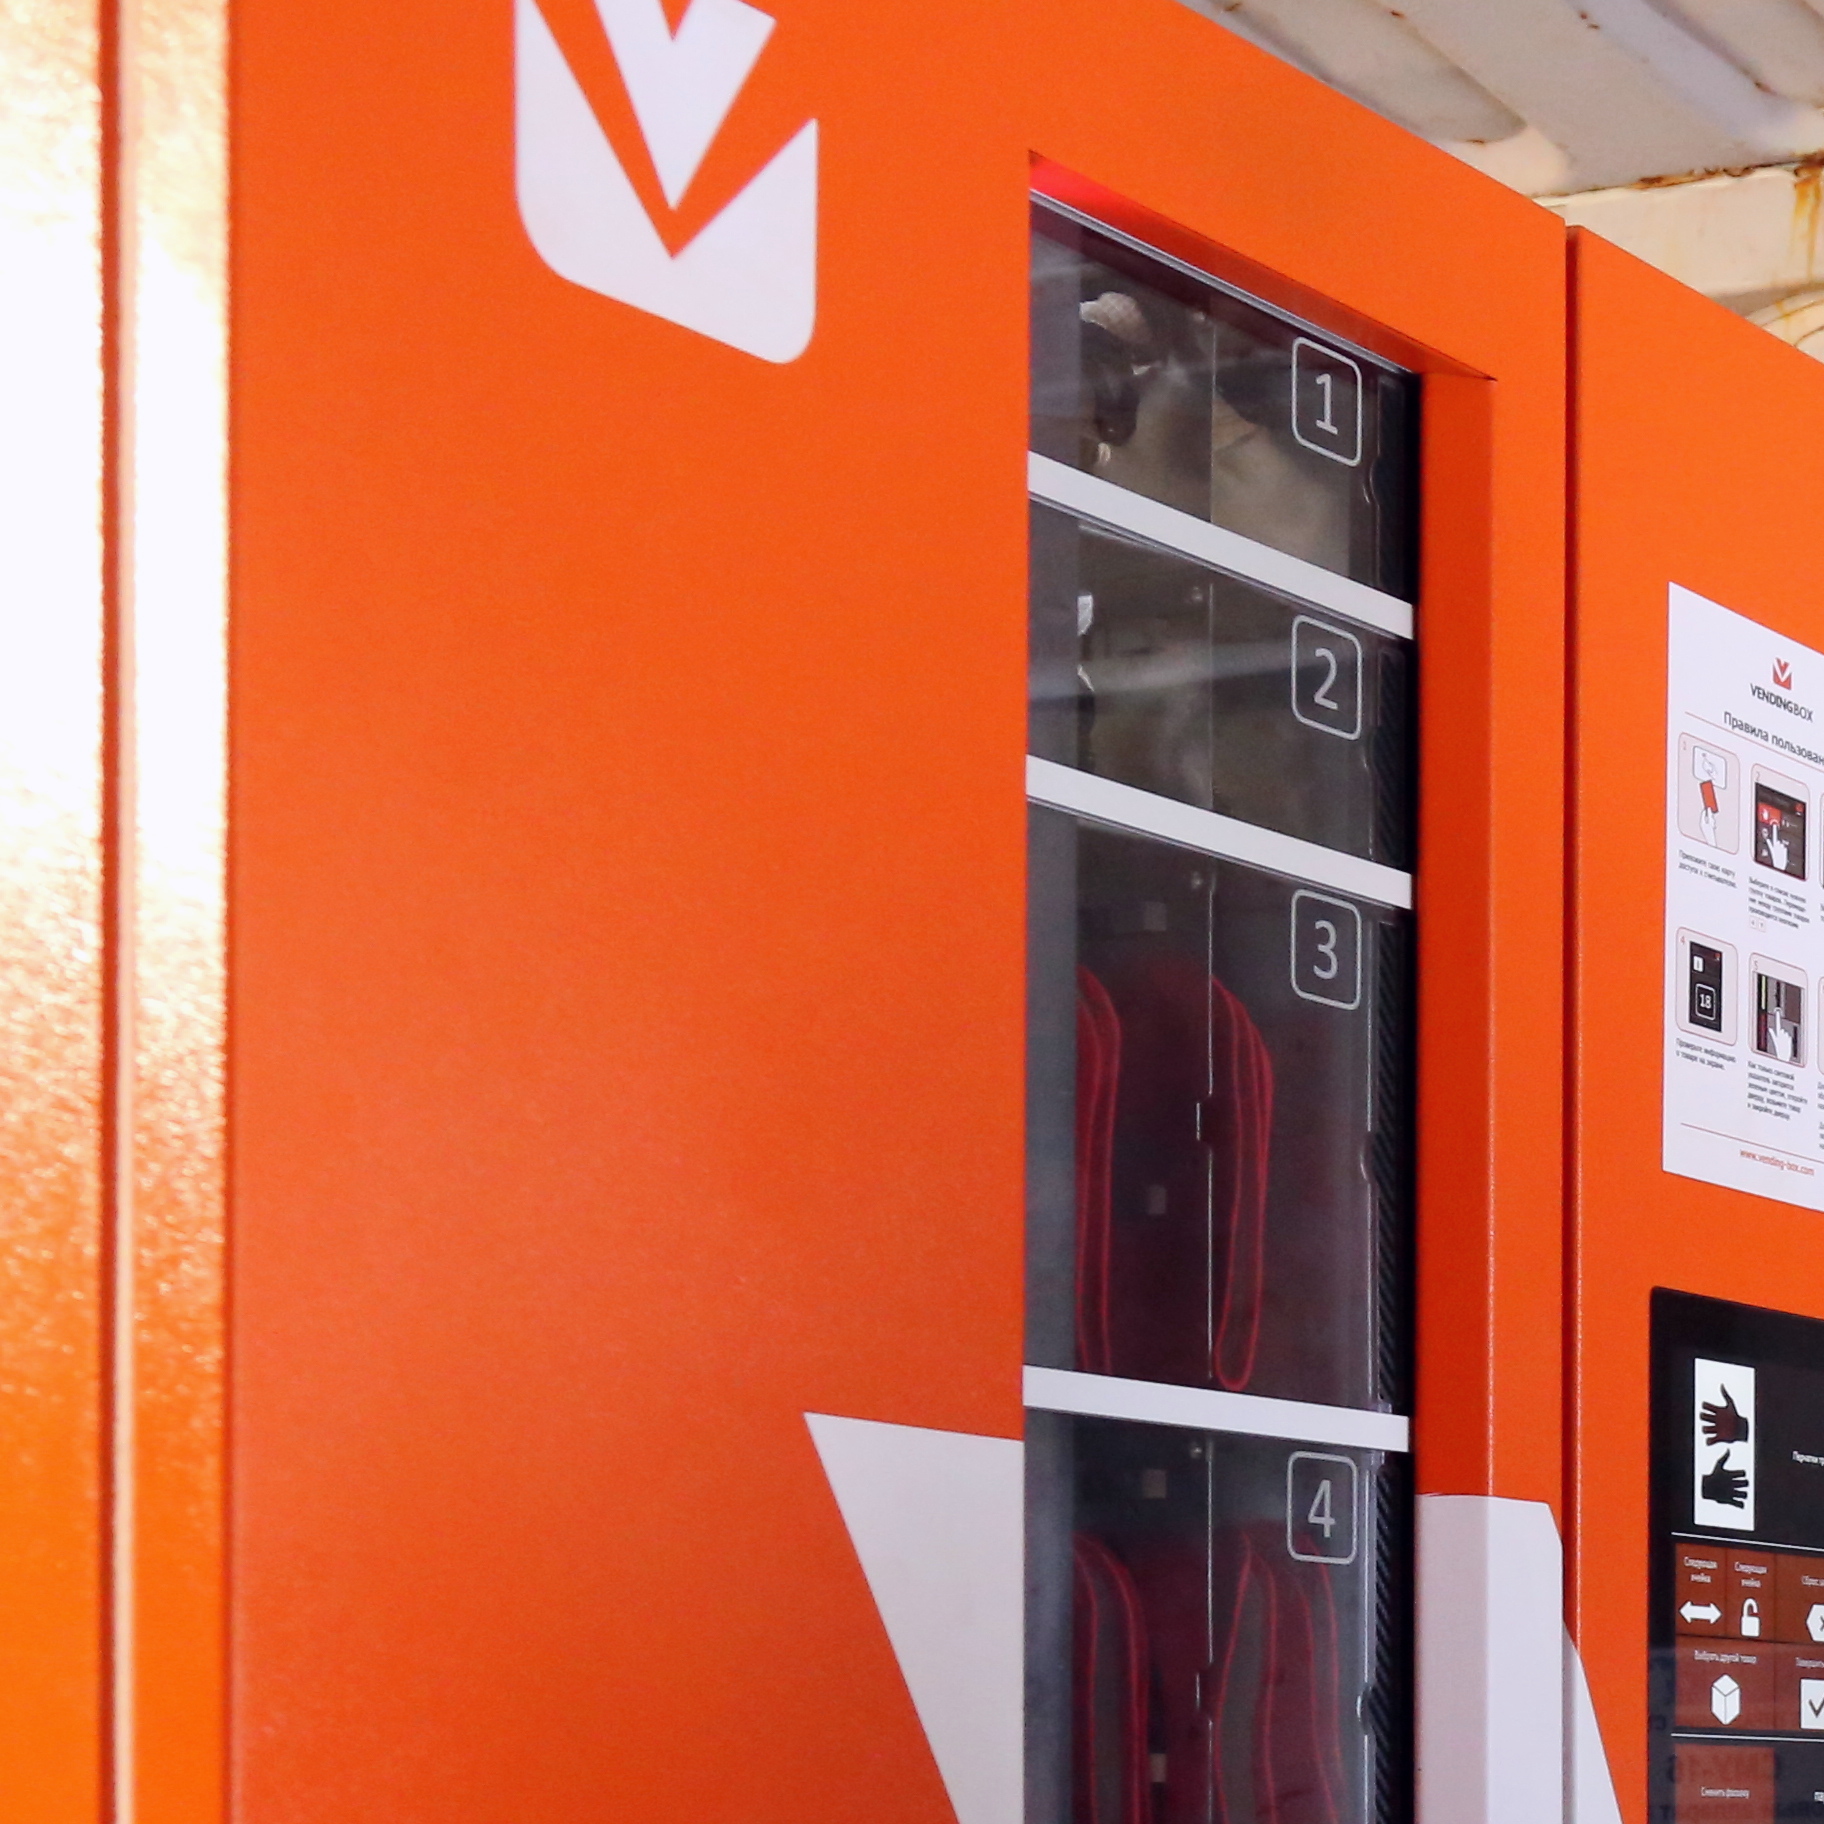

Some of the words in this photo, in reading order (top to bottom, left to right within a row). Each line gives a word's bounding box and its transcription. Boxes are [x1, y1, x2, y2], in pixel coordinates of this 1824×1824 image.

[1315, 372, 1338, 435] 1
[1314, 647, 1339, 710] 2
[1750, 683, 1813, 723] VENDINGBOX
[1723, 710, 1768, 742] Правила
[1314, 920, 1338, 980] 3
[1740, 1150, 1814, 1176] www.vending-box.com
[1308, 1479, 1336, 1539] 4
